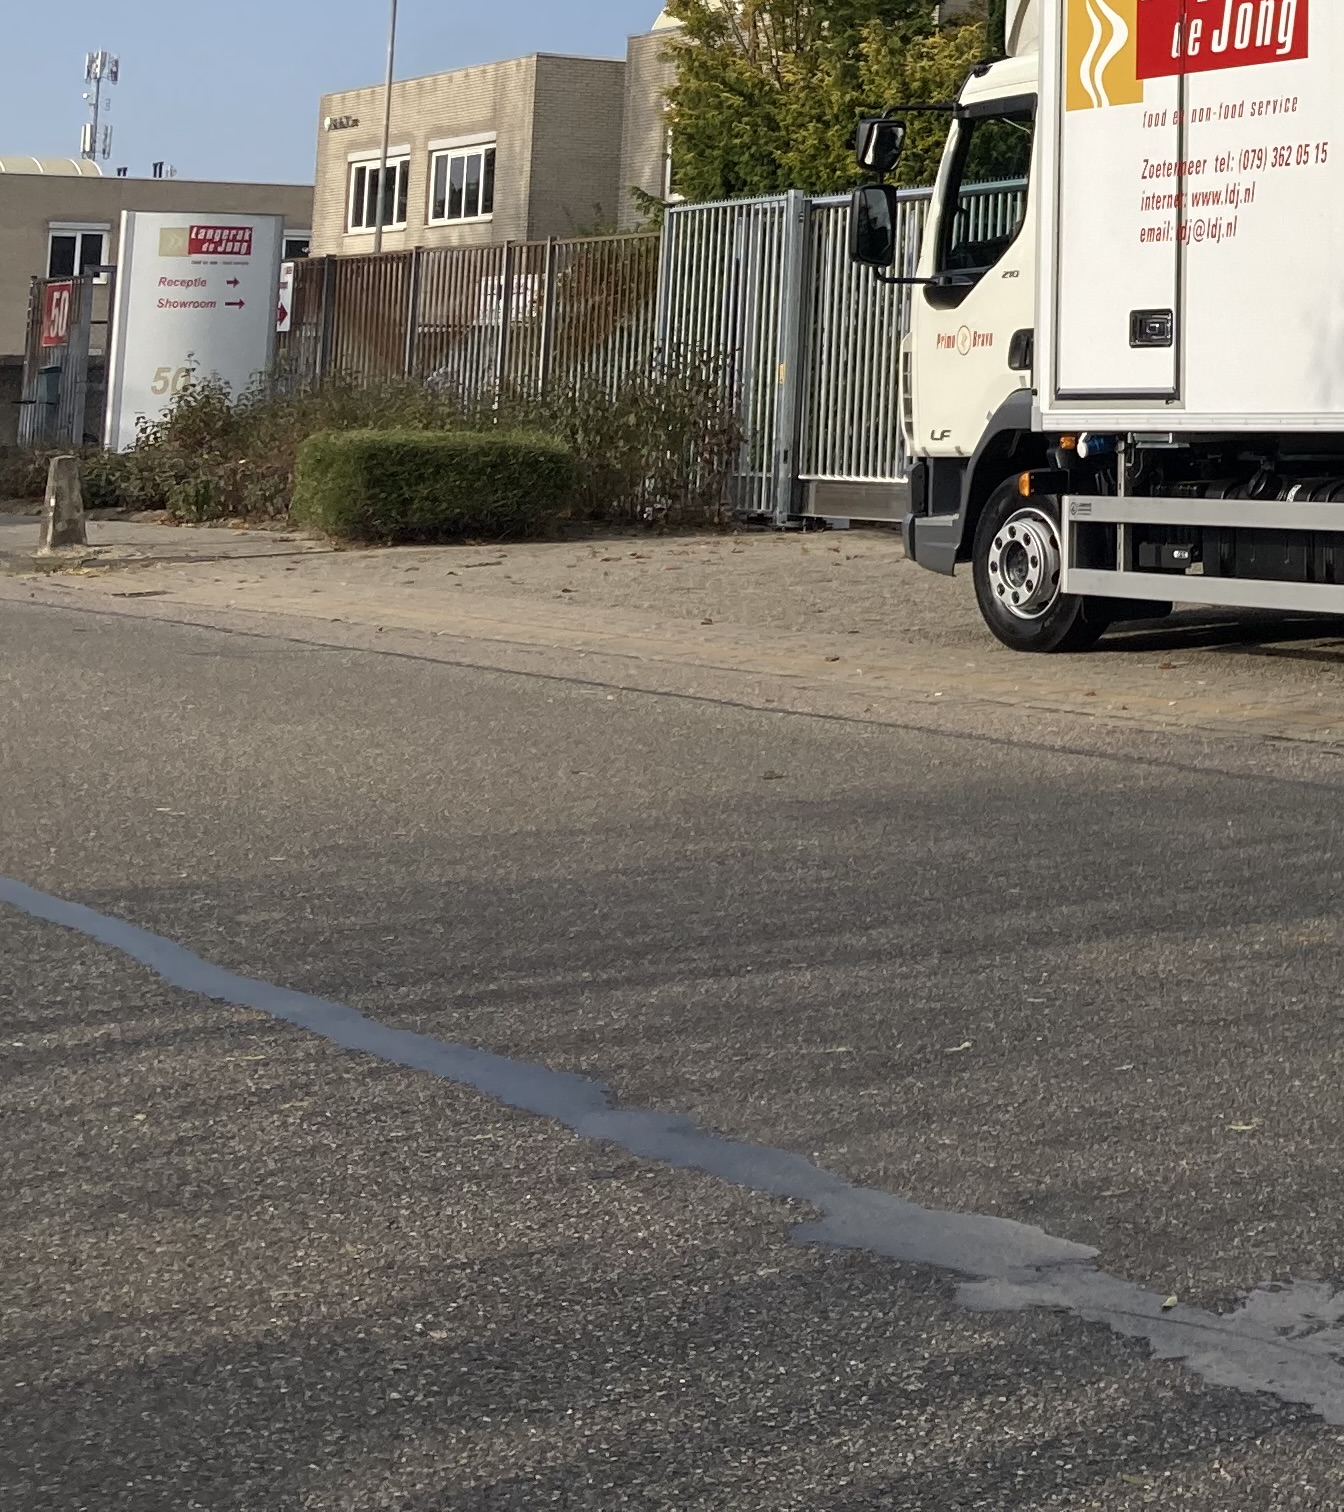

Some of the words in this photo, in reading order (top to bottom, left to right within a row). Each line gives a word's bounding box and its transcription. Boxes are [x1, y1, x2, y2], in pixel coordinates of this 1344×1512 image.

[1143, 109, 1168, 128] food
[1191, 100, 1245, 124] non-food
[1250, 95, 1298, 117] service
[1141, 157, 1207, 180] Zoetermeer
[1214, 151, 1235, 174] tel:
[1238, 146, 1268, 174] (079)
[1271, 145, 1293, 168] 362
[1295, 143, 1310, 166] 05
[1315, 141, 1329, 164] 15
[1191, 181, 1256, 209] www.ldj.nl
[191, 226, 252, 242] Langerak
[1140, 220, 1173, 243] email:
[202, 242, 214, 252] de
[217, 241, 248, 255] Jong
[158, 276, 207, 289] Receptie
[1001, 270, 1020, 279] 210
[157, 298, 217, 309] Showroom
[50, 290, 69, 338] 50
[936, 333, 956, 350] Primo
[972, 331, 993, 348] Bravo
[151, 366, 192, 396] 50
[930, 429, 952, 442] LF
